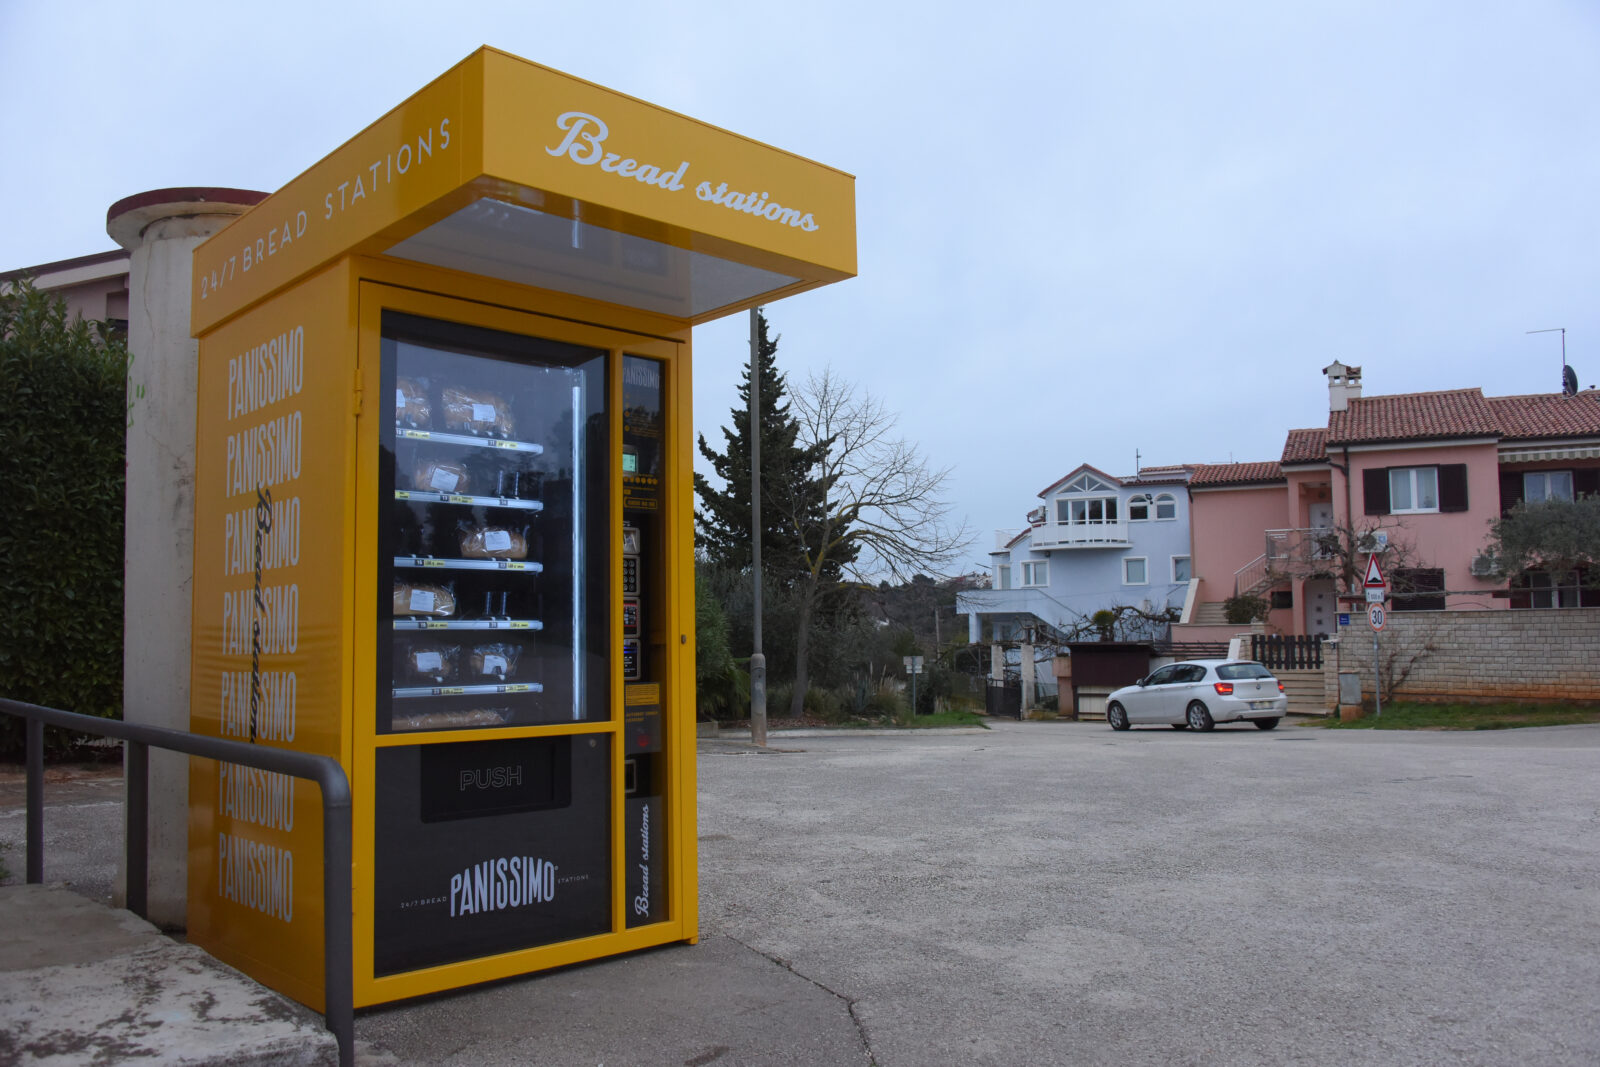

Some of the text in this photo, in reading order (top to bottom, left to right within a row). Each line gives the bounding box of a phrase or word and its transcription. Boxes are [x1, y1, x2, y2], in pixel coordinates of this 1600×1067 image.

[201, 118, 450, 299] 24/7 BREAD STATIONS
[545, 111, 819, 231] Bread stations
[228, 325, 304, 420] PANISSIMO
[226, 410, 302, 498] PANISSIMO
[1372, 610, 1383, 624] 30
[460, 766, 522, 791] PUSH
[218, 832, 293, 923] PANISSIMO
[634, 804, 649, 917] Bread stations
